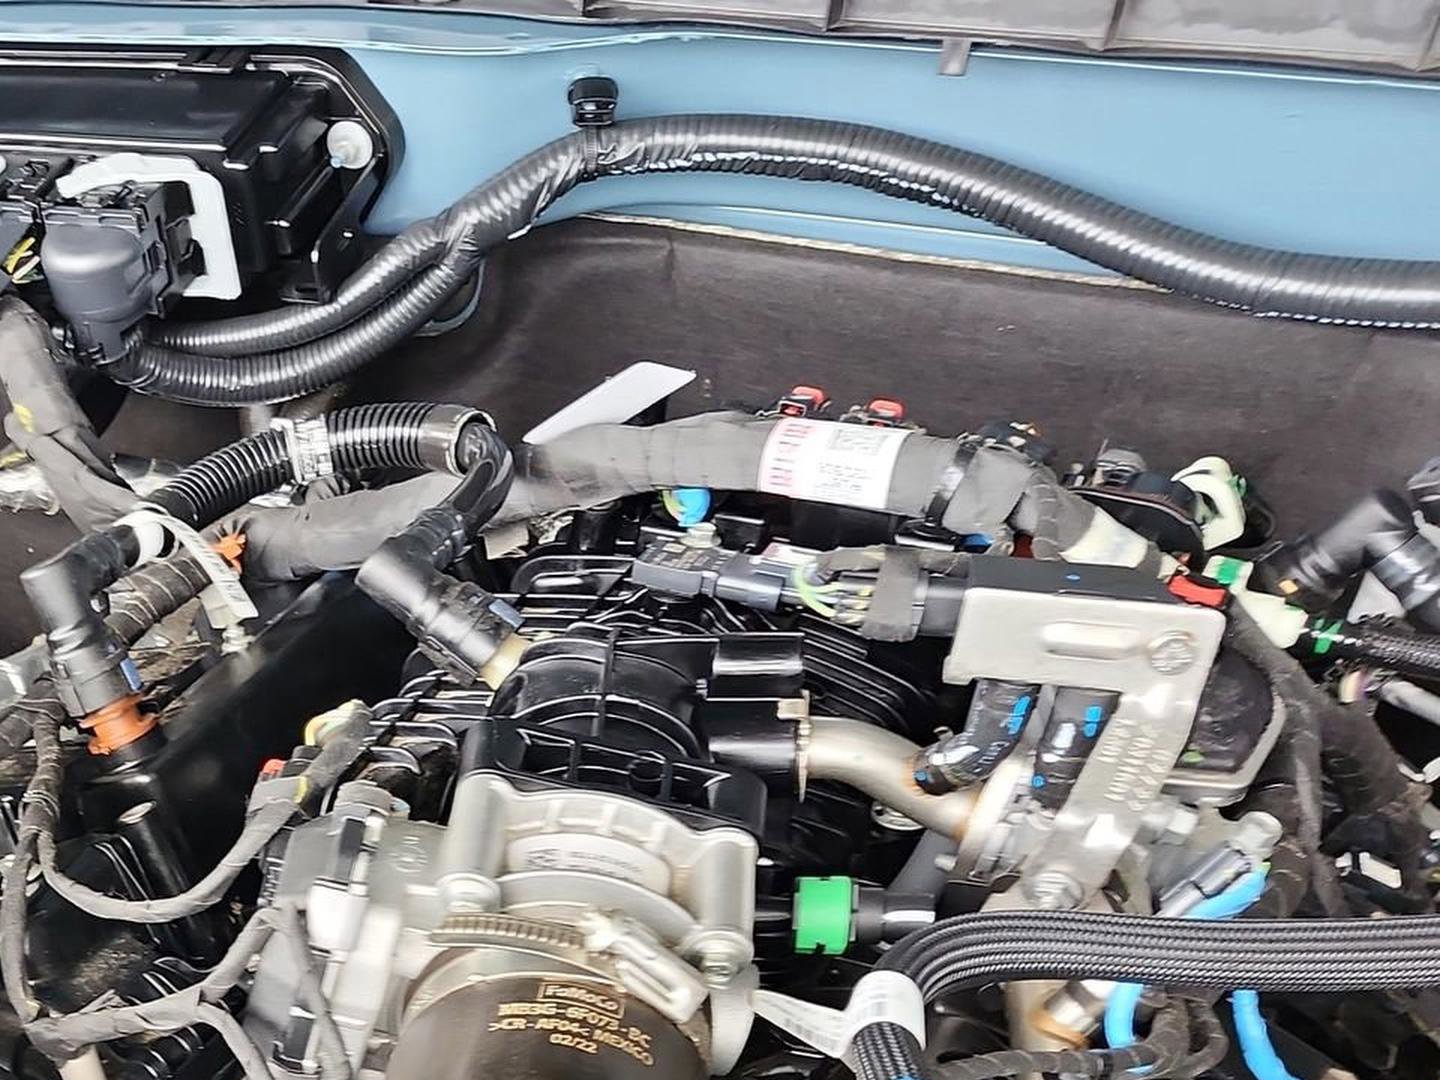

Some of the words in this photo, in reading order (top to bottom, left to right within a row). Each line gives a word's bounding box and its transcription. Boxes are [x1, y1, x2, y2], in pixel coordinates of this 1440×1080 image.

[543, 985, 619, 1011] FoMoCo
[549, 1033, 598, 1054] 02/22
[592, 1029, 654, 1066] MEXICO
